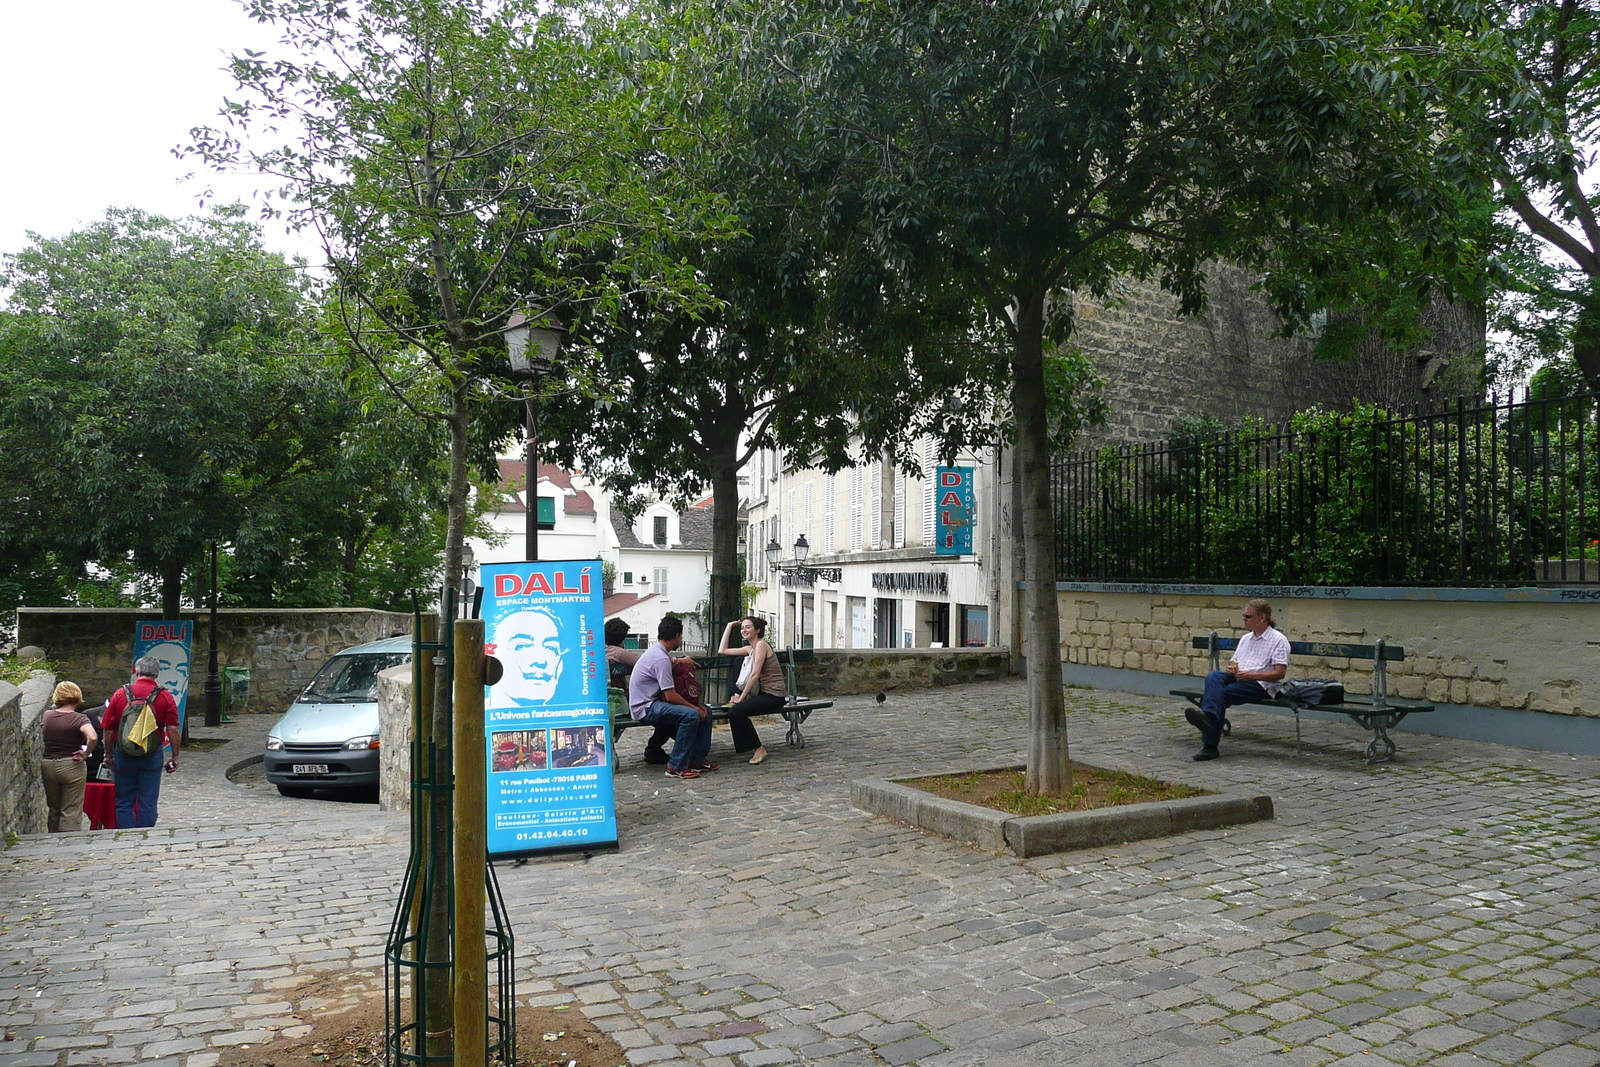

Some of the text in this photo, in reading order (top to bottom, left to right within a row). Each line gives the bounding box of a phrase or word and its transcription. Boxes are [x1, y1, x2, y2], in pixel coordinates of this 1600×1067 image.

[496, 596, 591, 606] ESPACE MONTMARTRE
[579, 614, 587, 634] jours
[581, 668, 589, 695] Ouvert
[490, 707, 604, 721] L'Univers fantasmagorique
[523, 776, 550, 785] Poulbot
[501, 794, 598, 804] www.daliparis.com
[544, 810, 577, 818] Galerie
[581, 808, 603, 816] d'Art
[544, 816, 578, 824] Animations
[579, 814, 603, 822] enfants
[516, 828, 588, 840] 01.42.64.40.10
